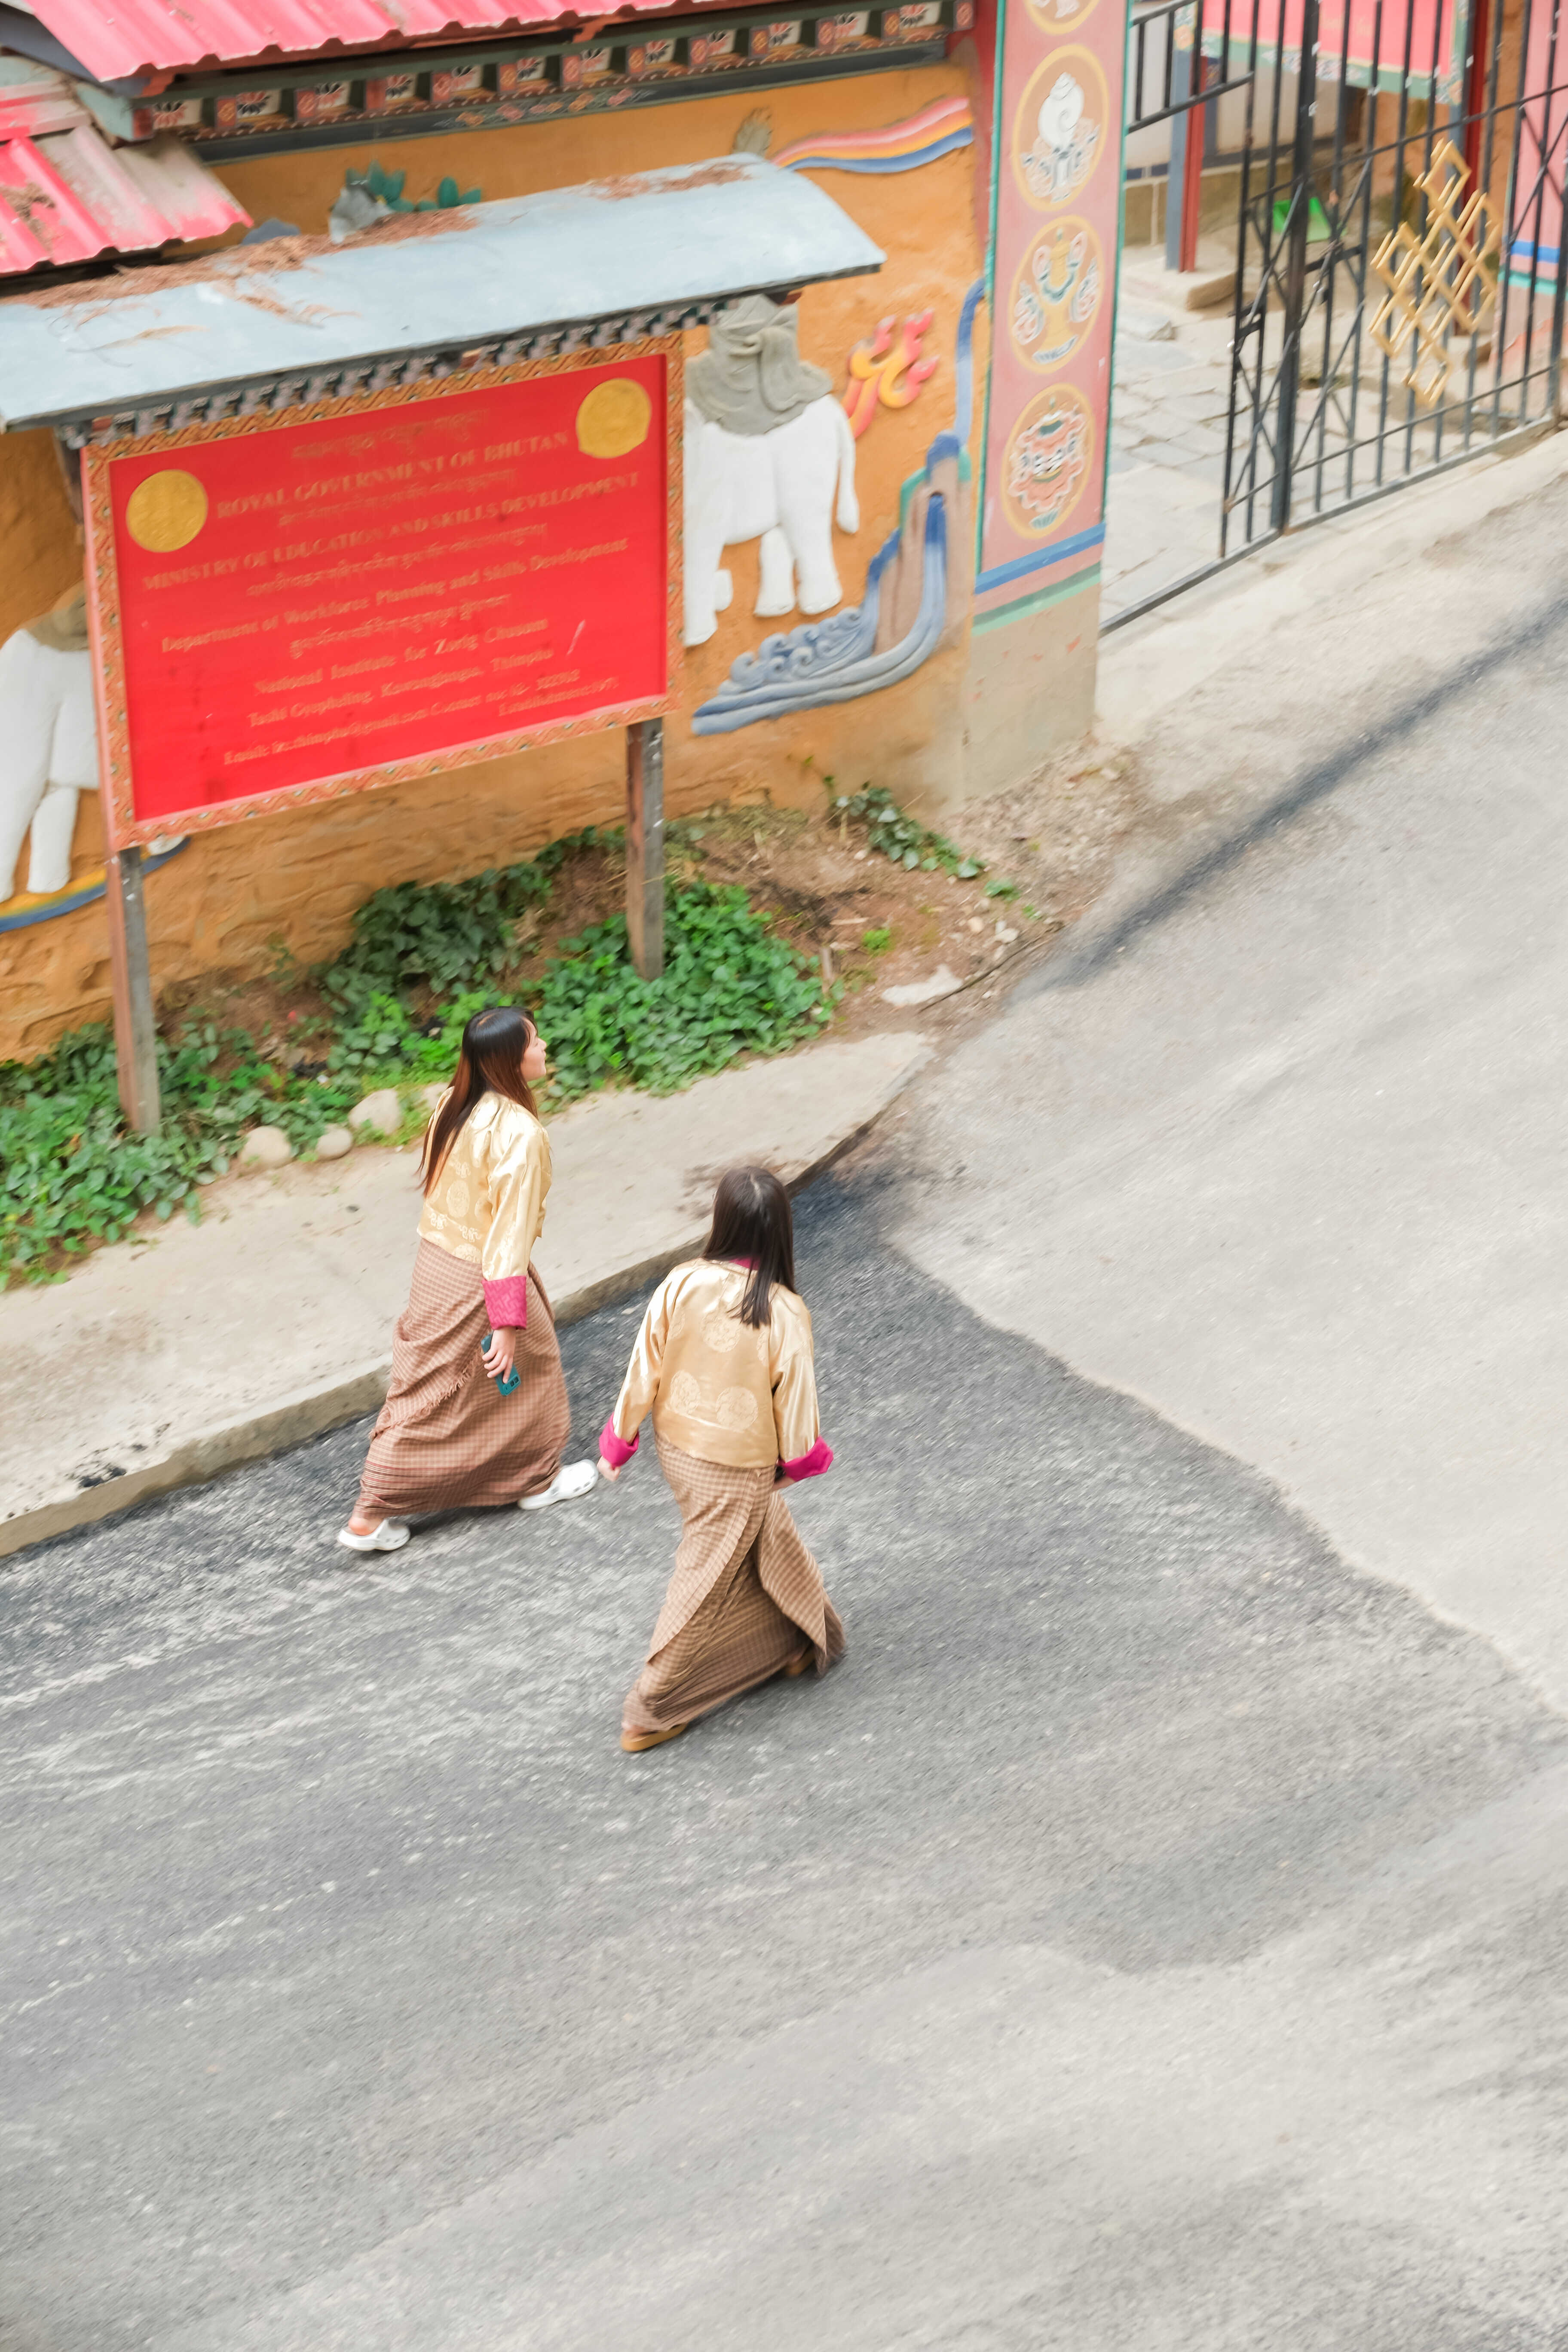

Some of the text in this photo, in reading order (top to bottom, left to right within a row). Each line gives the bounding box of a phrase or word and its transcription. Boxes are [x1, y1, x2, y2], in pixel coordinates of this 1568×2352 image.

[217, 487, 288, 518] ROYAL
[294, 456, 445, 502] GOVERNMENT
[450, 448, 479, 468] OF
[484, 432, 568, 462] BHUTAN
[142, 556, 241, 590] MINISTRY
[243, 550, 267, 569] OF
[273, 527, 384, 563] EDUCATION
[389, 518, 429, 538] AND
[431, 502, 498, 530] SKILLS
[501, 472, 639, 514] DEVELOPMENT
[162, 537, 628, 653] Department of Workforce Planning and Skills Development
[246, 706, 288, 727] Tashi
[490, 648, 554, 672] Thimphu
[254, 618, 549, 695] National Institute for Zorig Chusum
[431, 693, 481, 715] Contact
